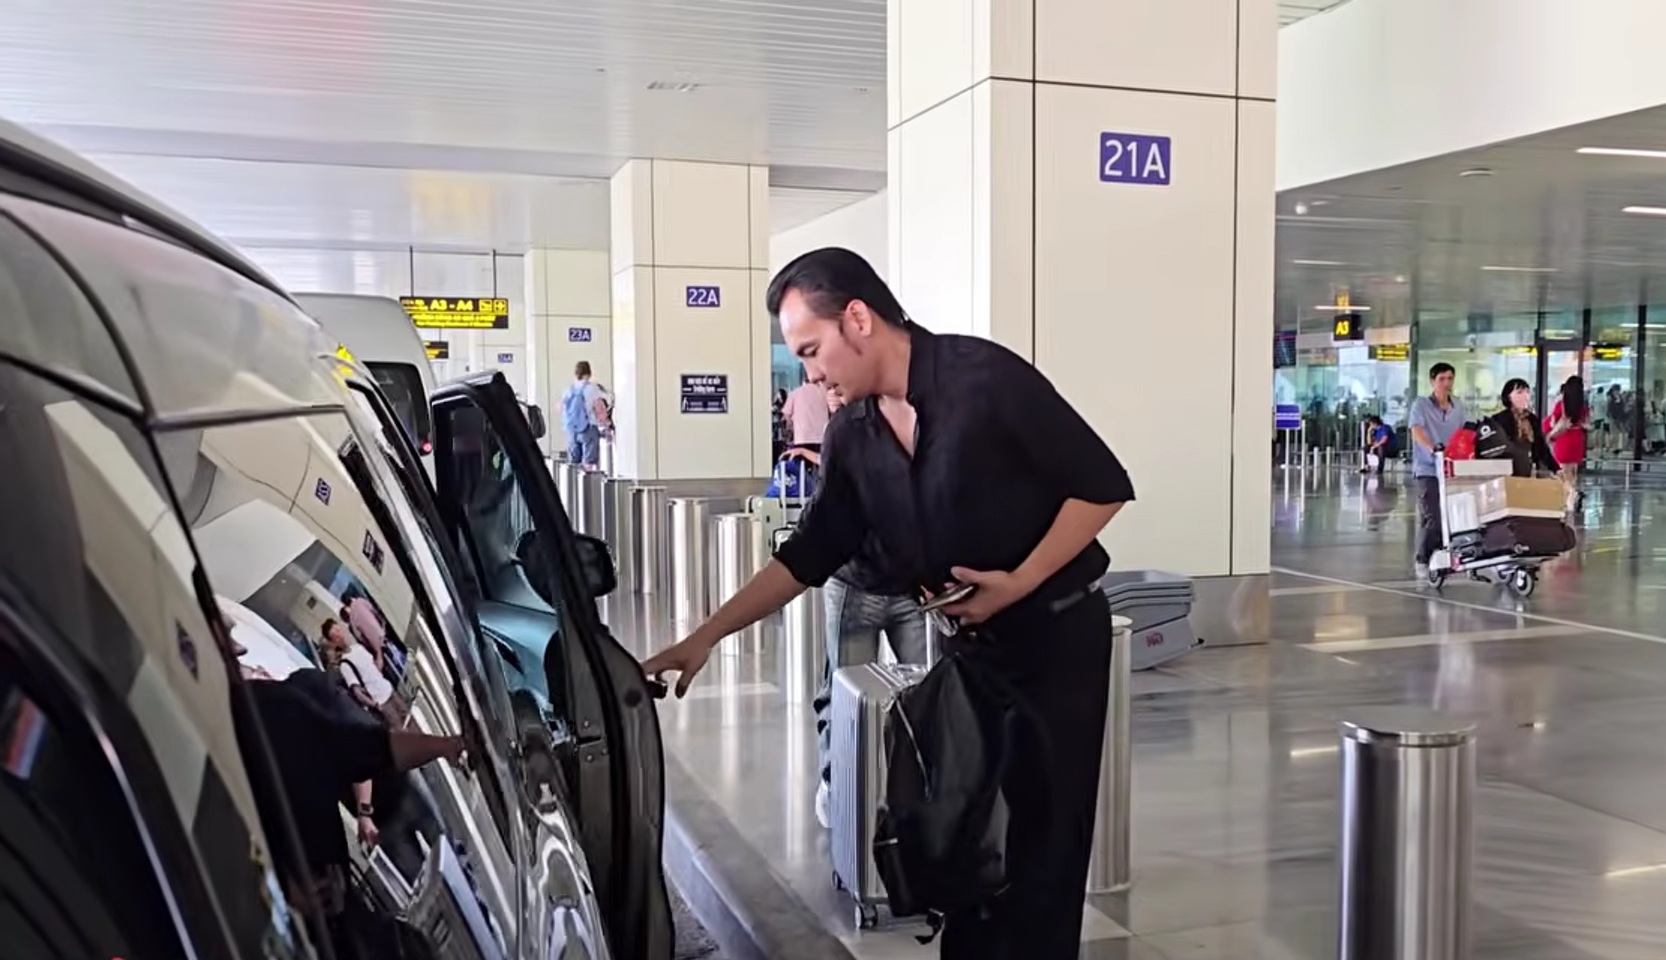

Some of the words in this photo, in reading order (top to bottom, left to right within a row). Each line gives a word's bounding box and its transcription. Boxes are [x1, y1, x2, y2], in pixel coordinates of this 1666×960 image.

[1104, 139, 1166, 179] 21A
[688, 288, 718, 305] 22A
[430, 299, 448, 311] A3
[456, 299, 474, 311] A4
[570, 329, 590, 341] 23A
[1335, 320, 1350, 335] A3
